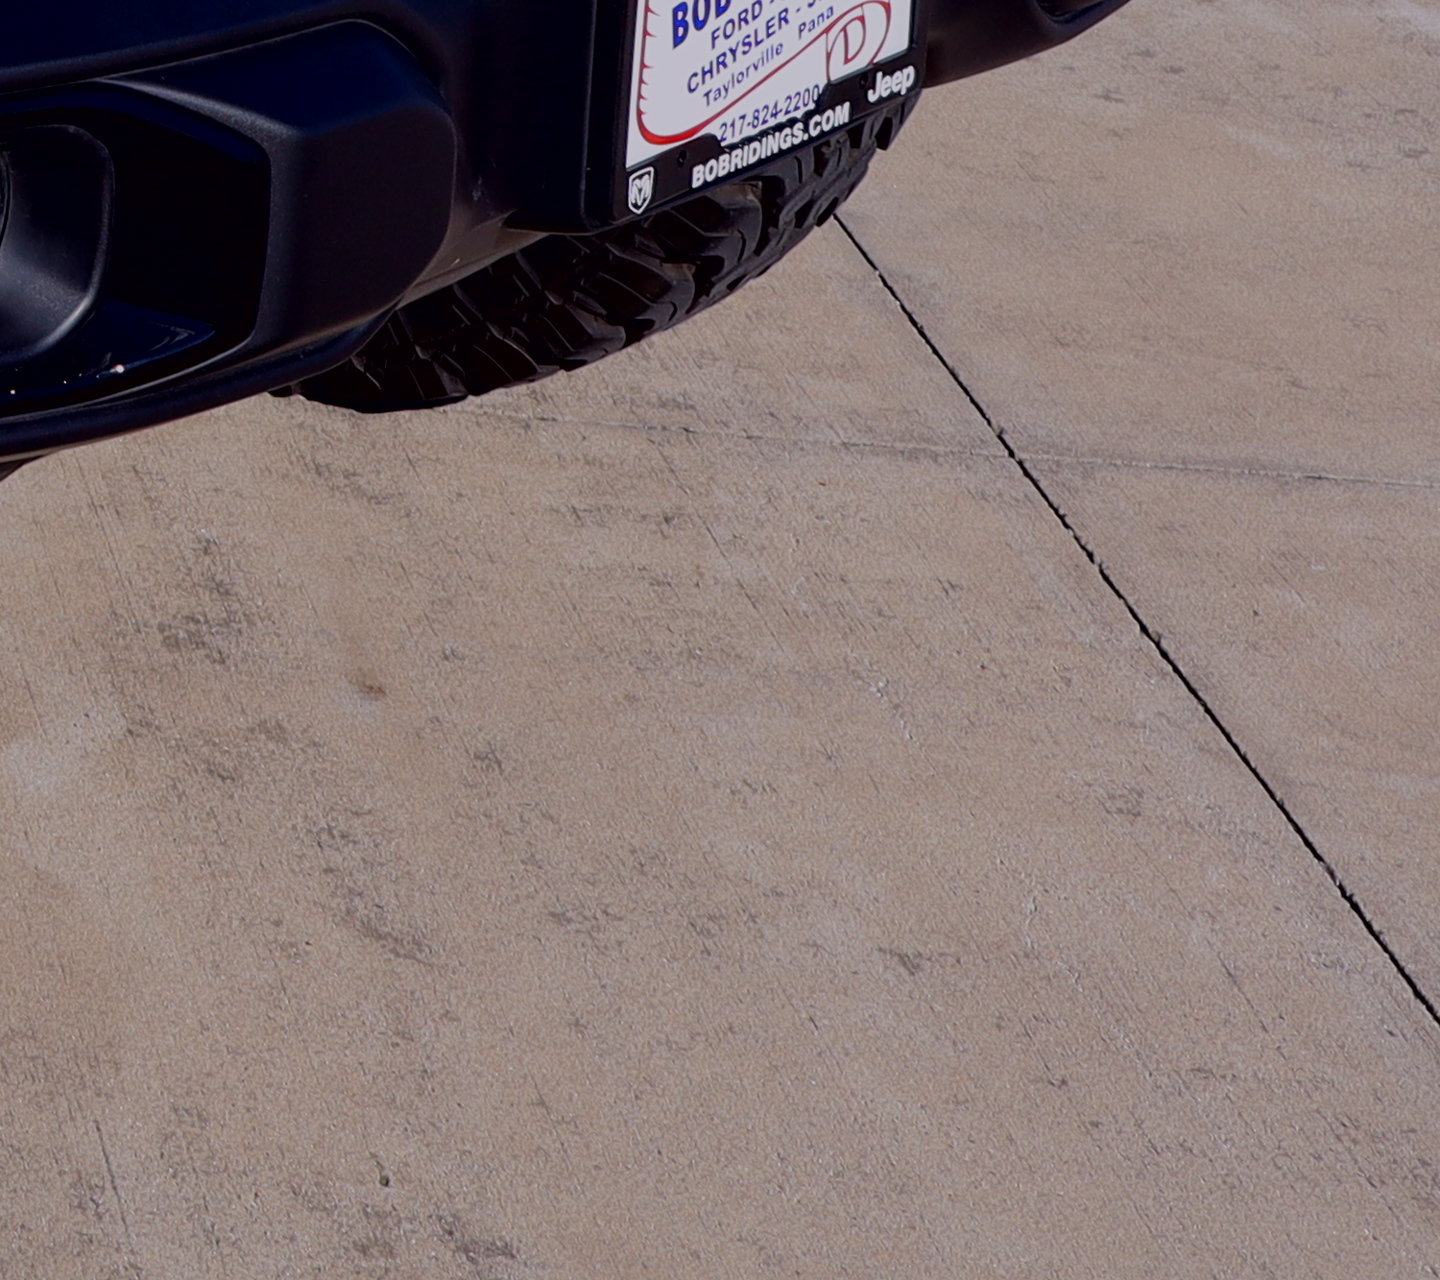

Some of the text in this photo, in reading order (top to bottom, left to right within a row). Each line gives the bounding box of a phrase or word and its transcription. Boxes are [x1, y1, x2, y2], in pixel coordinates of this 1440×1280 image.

[686, 11, 791, 95] CHRYSLER
[702, 4, 835, 108] Taylorville Pana
[710, 0, 764, 50] FORD
[718, 83, 822, 144] 217-824-2200
[866, 63, 916, 104] Jeep
[691, 101, 852, 190] BOBRIDINGS.COM
